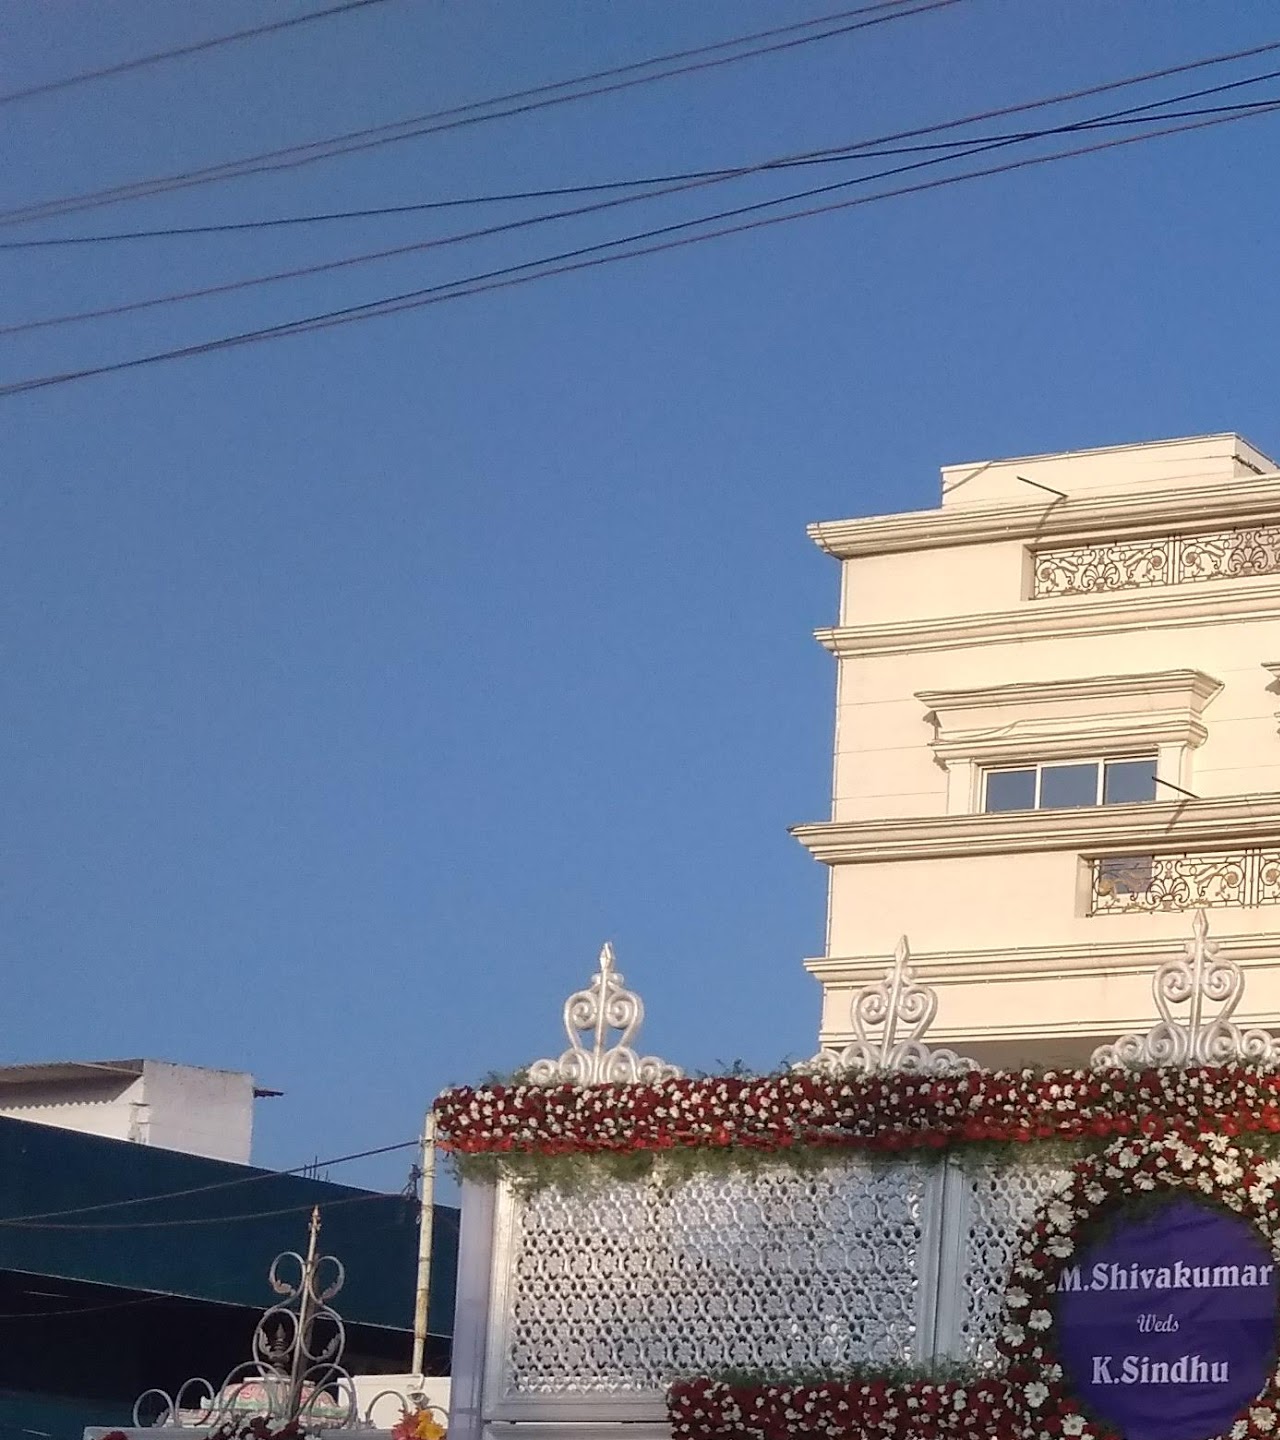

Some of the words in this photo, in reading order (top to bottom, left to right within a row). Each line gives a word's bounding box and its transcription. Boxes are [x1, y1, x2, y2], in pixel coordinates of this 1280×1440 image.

[1057, 1259, 1274, 1293] M.Shivakumar
[1136, 1313, 1180, 1333] Weds
[1091, 1355, 1230, 1385] K.Sindhu
